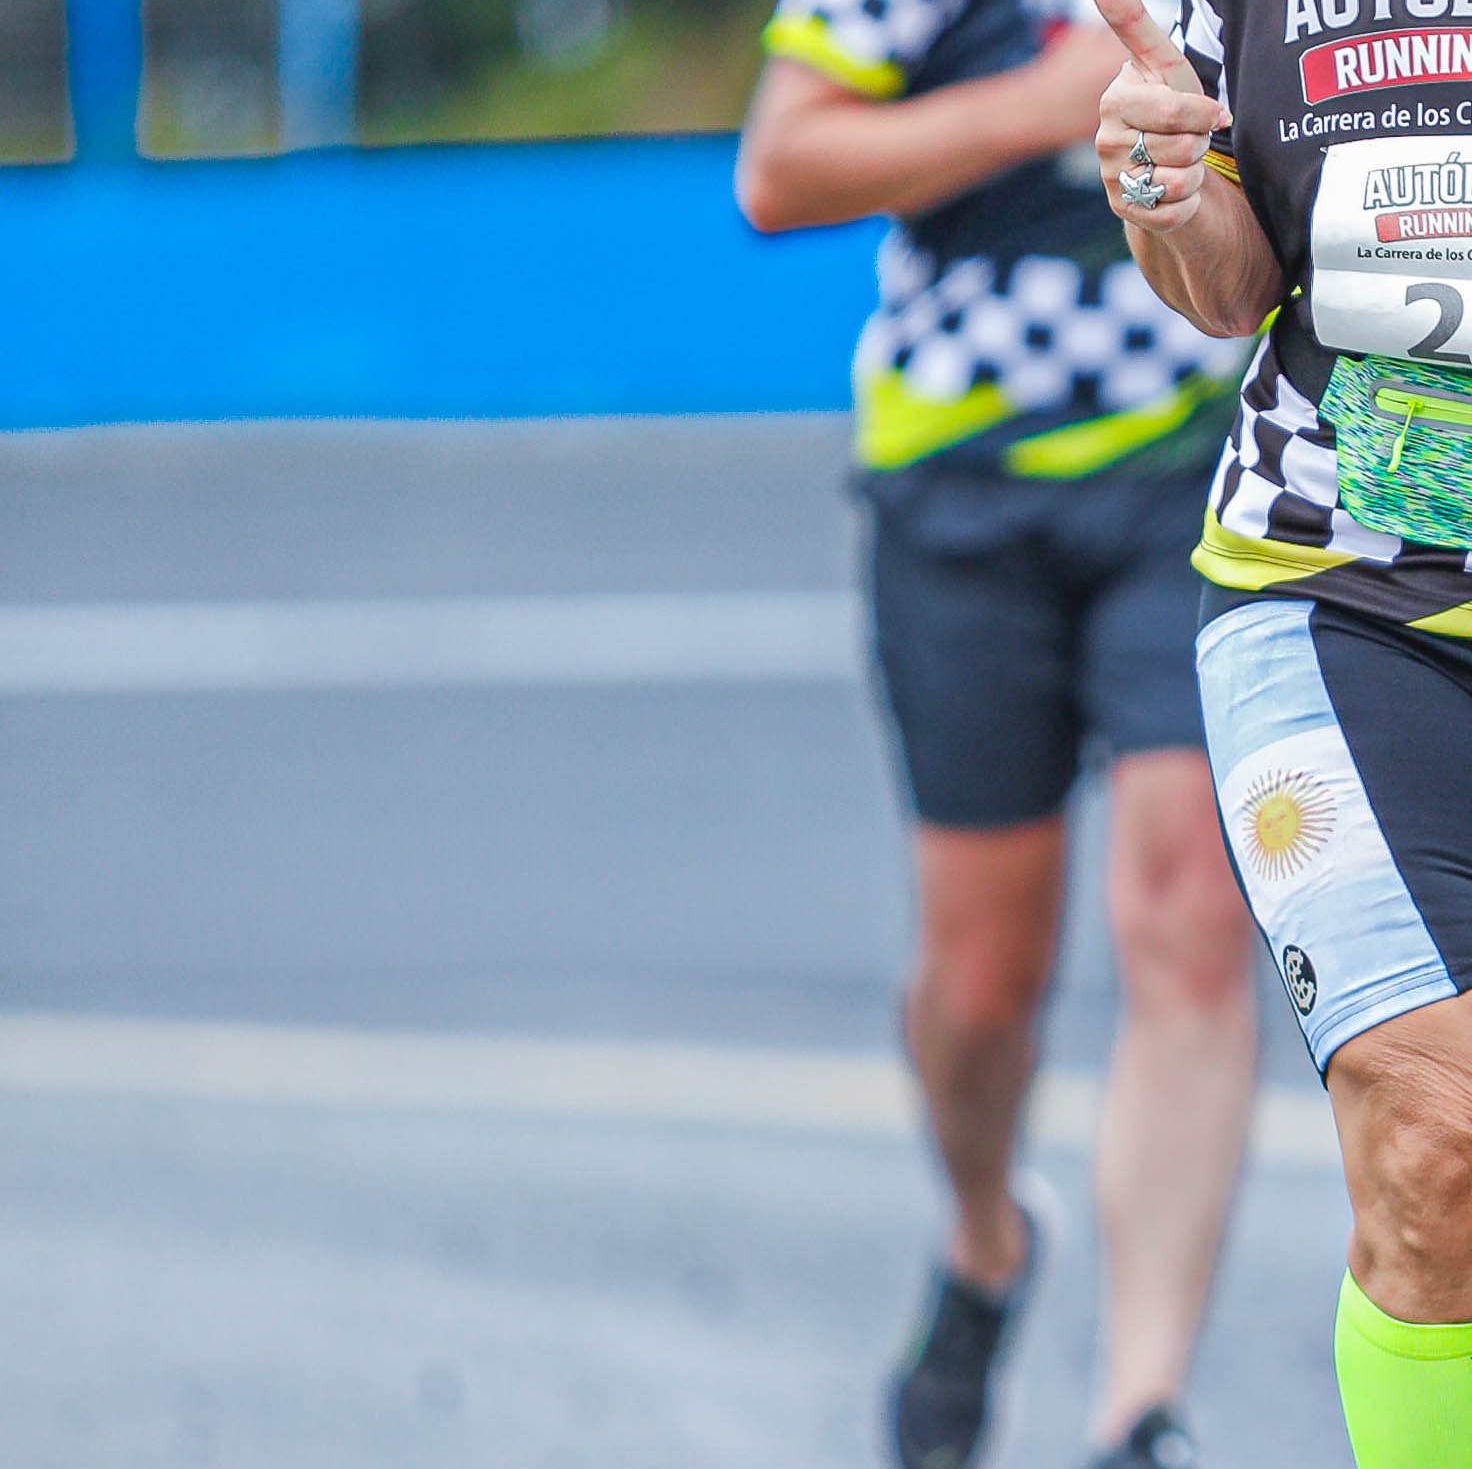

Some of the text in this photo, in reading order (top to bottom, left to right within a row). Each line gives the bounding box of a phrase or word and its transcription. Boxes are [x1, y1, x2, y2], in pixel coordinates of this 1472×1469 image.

[1279, 119, 1299, 142] La
[1301, 111, 1376, 137] Carrera
[1381, 103, 1411, 128] de
[1417, 102, 1450, 127] los
[1357, 246, 1372, 259] La
[1375, 246, 1423, 261] Carrera
[1426, 247, 1443, 261] de
[1446, 247, 1465, 262] los
